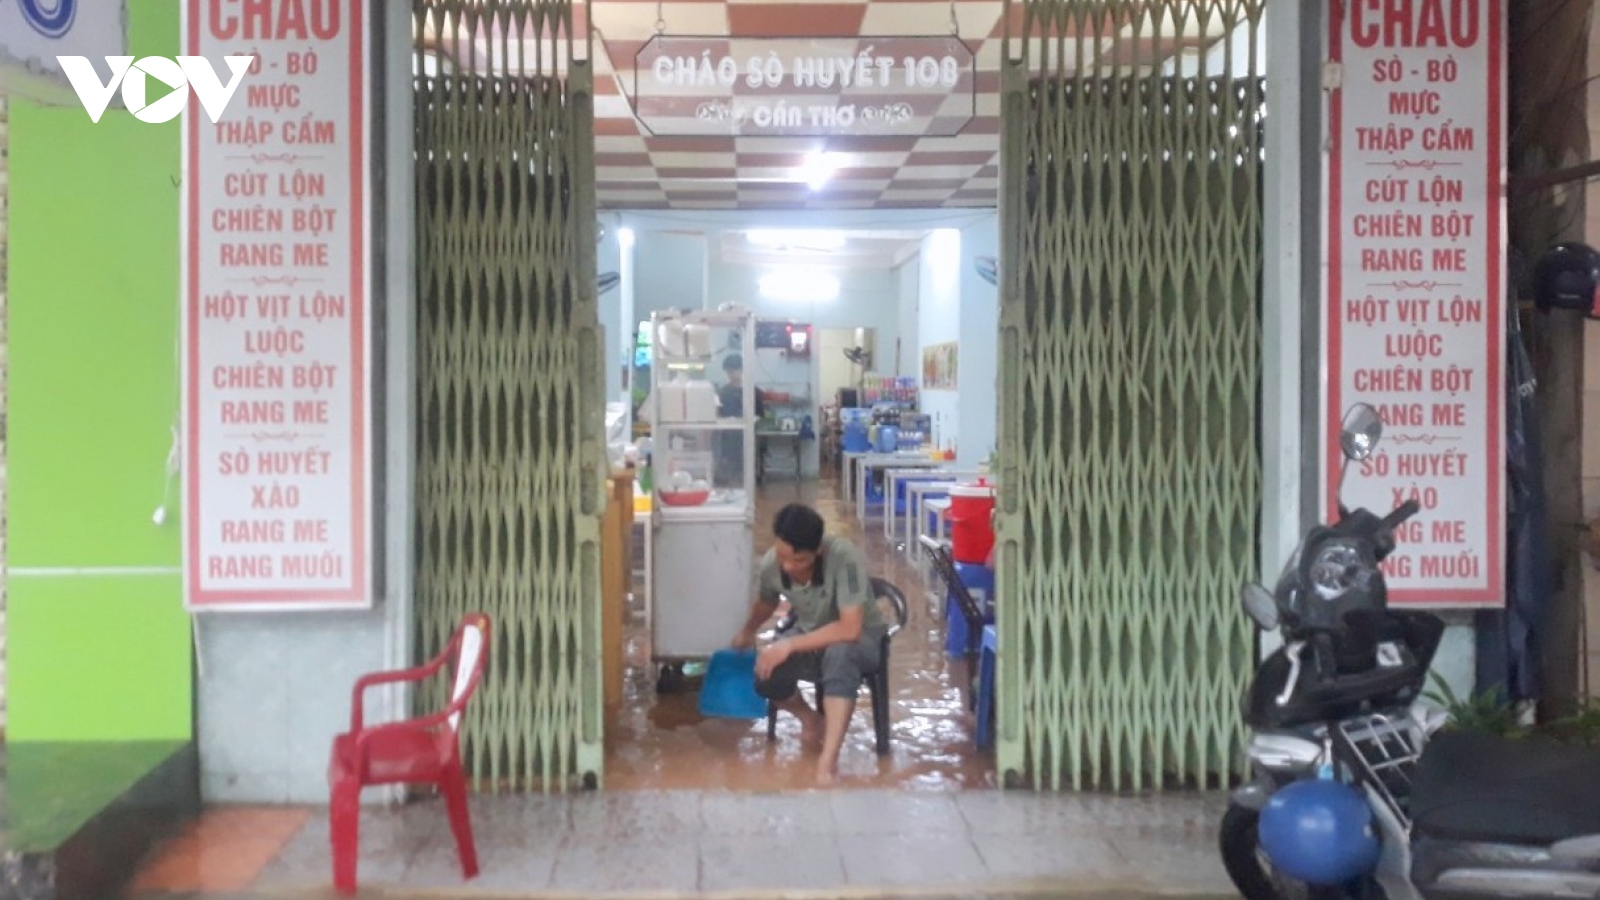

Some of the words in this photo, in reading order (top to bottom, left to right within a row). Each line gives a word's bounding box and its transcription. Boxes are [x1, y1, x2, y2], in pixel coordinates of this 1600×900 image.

[286, 46, 318, 75] BÒ
[655, 48, 737, 87] CHÁO
[746, 49, 783, 88] SÒ
[793, 45, 894, 87] HUYẾT
[904, 56, 958, 87] 108
[1372, 54, 1403, 82] SÒ
[1426, 54, 1457, 82] BÒ
[246, 83, 301, 114] MỰC
[1388, 89, 1440, 119] MỰC
[215, 114, 274, 147] THẬP
[808, 103, 856, 127] THƠ
[1355, 122, 1414, 154] THẬP
[224, 168, 268, 197] CÚT
[278, 168, 325, 200] LỘN
[1365, 174, 1408, 202] CÚT
[1418, 175, 1463, 207] LỘN
[211, 204, 283, 232] CHIÊN
[292, 204, 337, 236] BỘT
[1354, 209, 1422, 237] CHIÊN
[1431, 209, 1474, 241] BỘT
[219, 242, 283, 267] RANG
[293, 242, 329, 267] ME
[1361, 248, 1422, 271] RANG
[1432, 248, 1467, 271] ME
[204, 291, 249, 322] HỘT
[256, 295, 291, 322] VỊT
[300, 291, 345, 322] LỘN
[1346, 295, 1389, 327] HỘT
[1396, 300, 1430, 327] VỊT
[1437, 295, 1481, 327] LỘN
[244, 326, 304, 358] LUỘC
[1385, 330, 1443, 362] LUỘC
[212, 361, 284, 389] CHIÊN
[292, 360, 337, 393] BỘT
[1354, 365, 1423, 392] CHIÊN
[1431, 365, 1474, 396] BỘT
[221, 401, 284, 423] RANG
[293, 401, 328, 423] ME
[1377, 404, 1423, 426] ANG
[1432, 404, 1466, 426] ME
[218, 447, 249, 475] SÒ
[258, 444, 331, 474] HUYẾT
[1360, 448, 1389, 477] SÒ
[1397, 447, 1468, 476] HUYẾT
[221, 520, 284, 542] RANG
[293, 520, 328, 542] ME
[1432, 521, 1466, 543] ME
[209, 556, 272, 578] RANG
[281, 550, 342, 578] MUỐI
[1420, 549, 1479, 578] MUỐI
